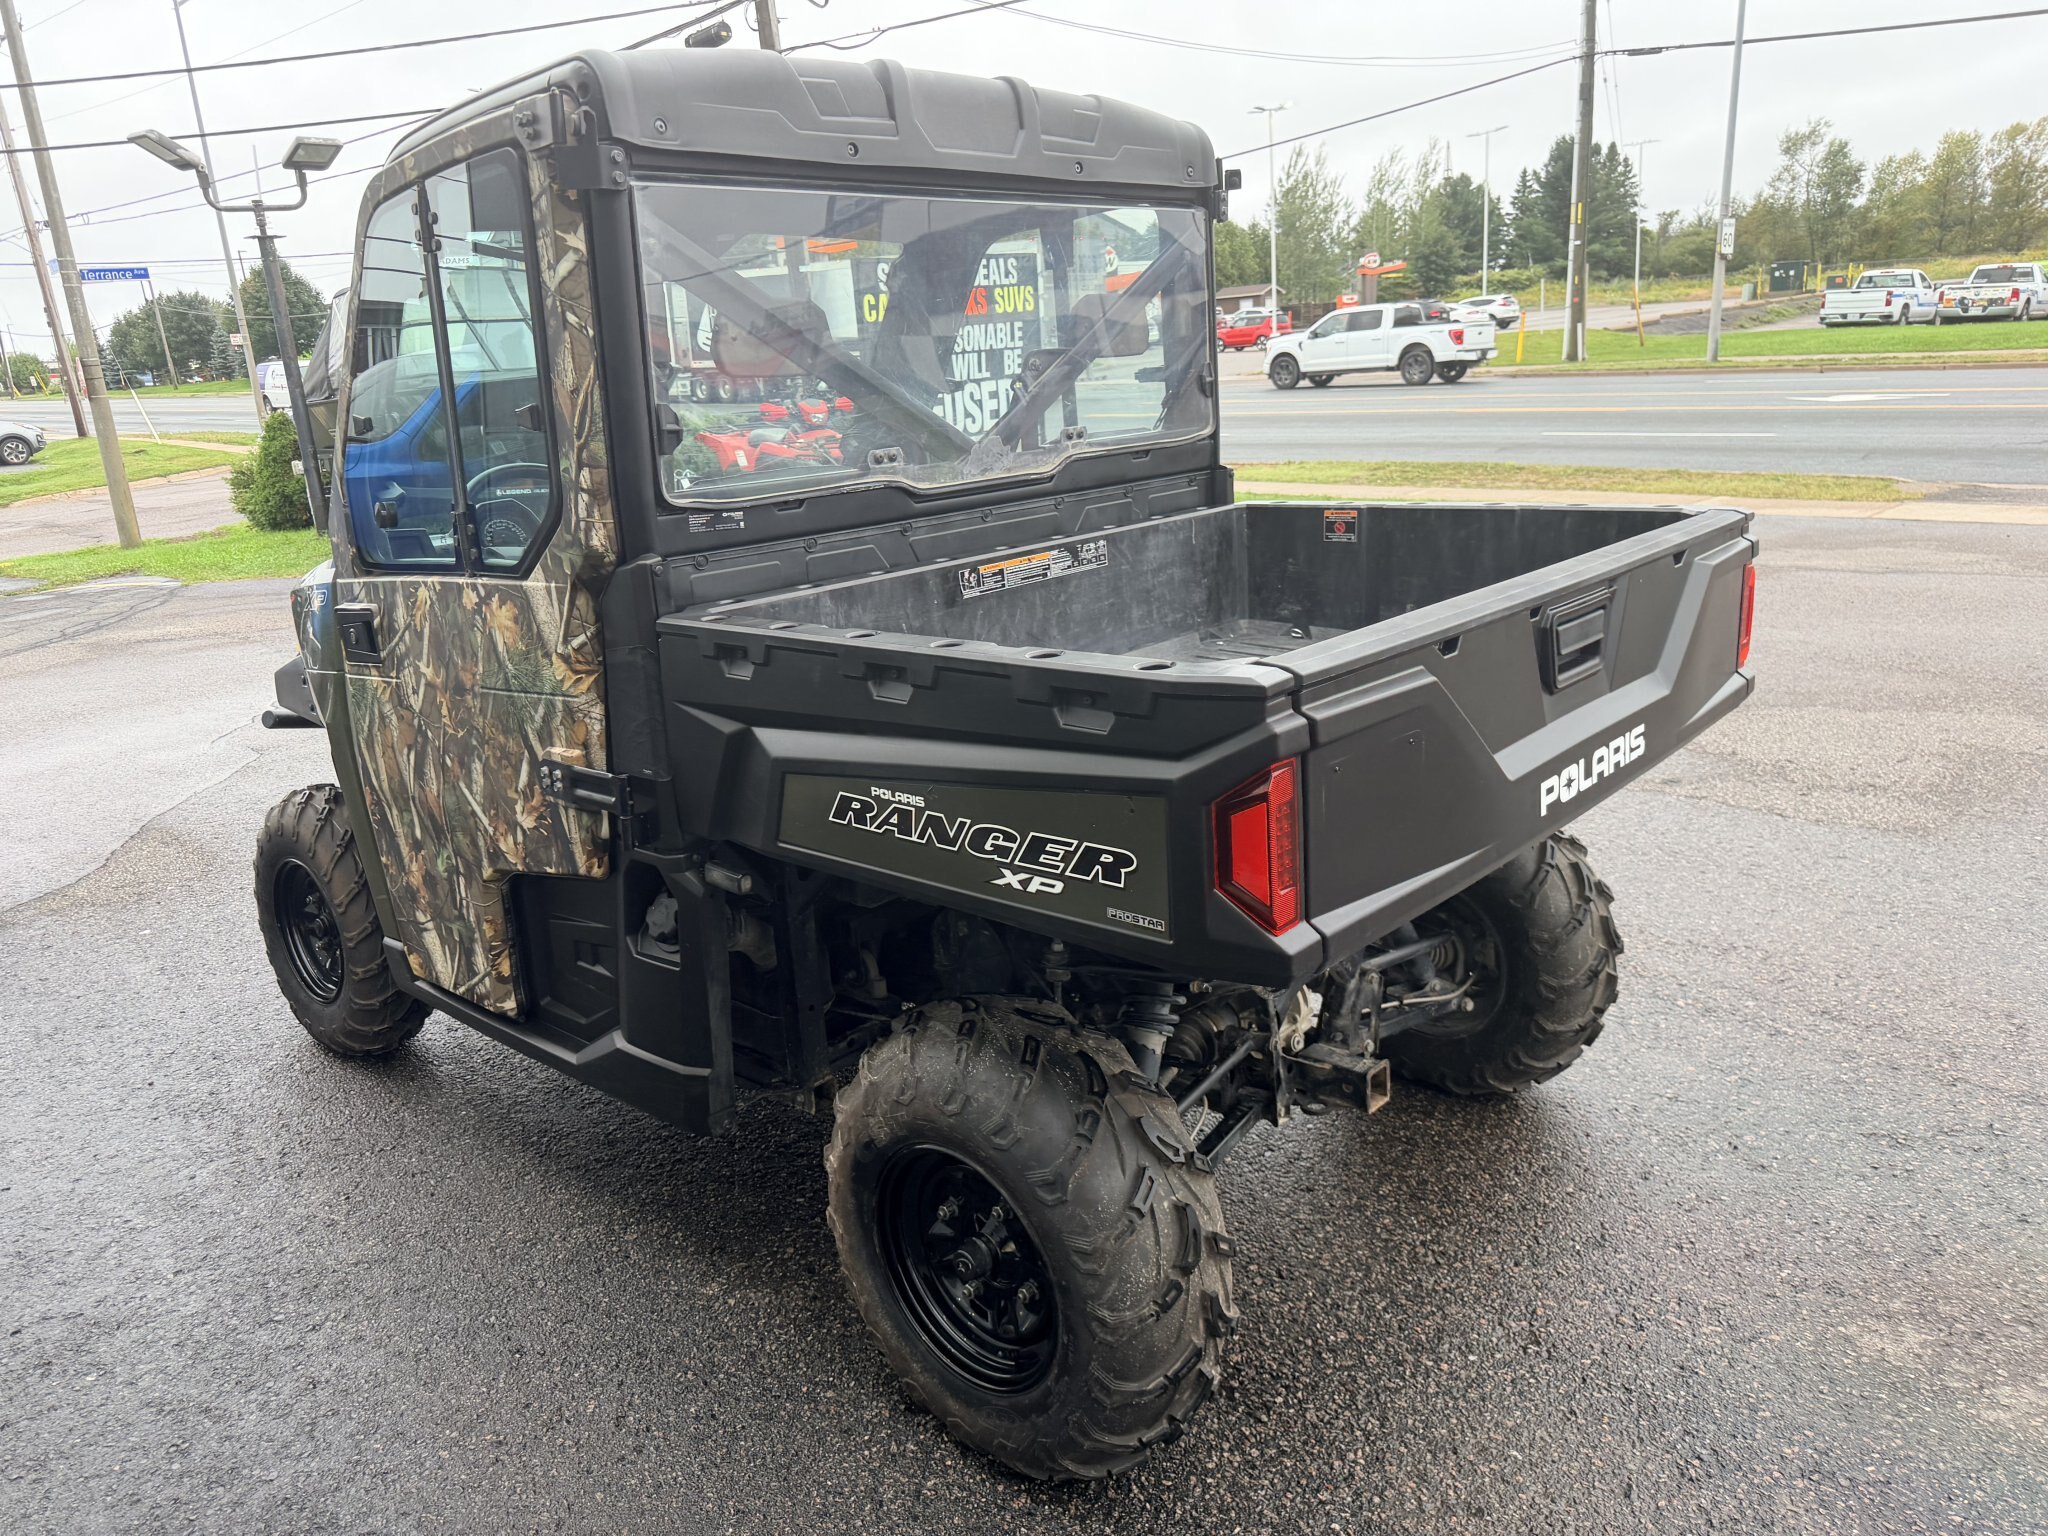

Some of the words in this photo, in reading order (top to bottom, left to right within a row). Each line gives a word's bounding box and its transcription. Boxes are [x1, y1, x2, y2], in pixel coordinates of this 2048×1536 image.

[1723, 232, 1732, 247] 60
[82, 270, 133, 280] Terrance
[994, 285, 1034, 314] SUVS
[951, 351, 991, 381] WILL
[1003, 348, 1022, 375] BE
[1540, 723, 1646, 817] POLARIS
[870, 786, 925, 808] POLARIS
[828, 791, 1138, 888] RANGER
[989, 867, 1065, 895] XP
[1106, 907, 1165, 931] PROSTAR
